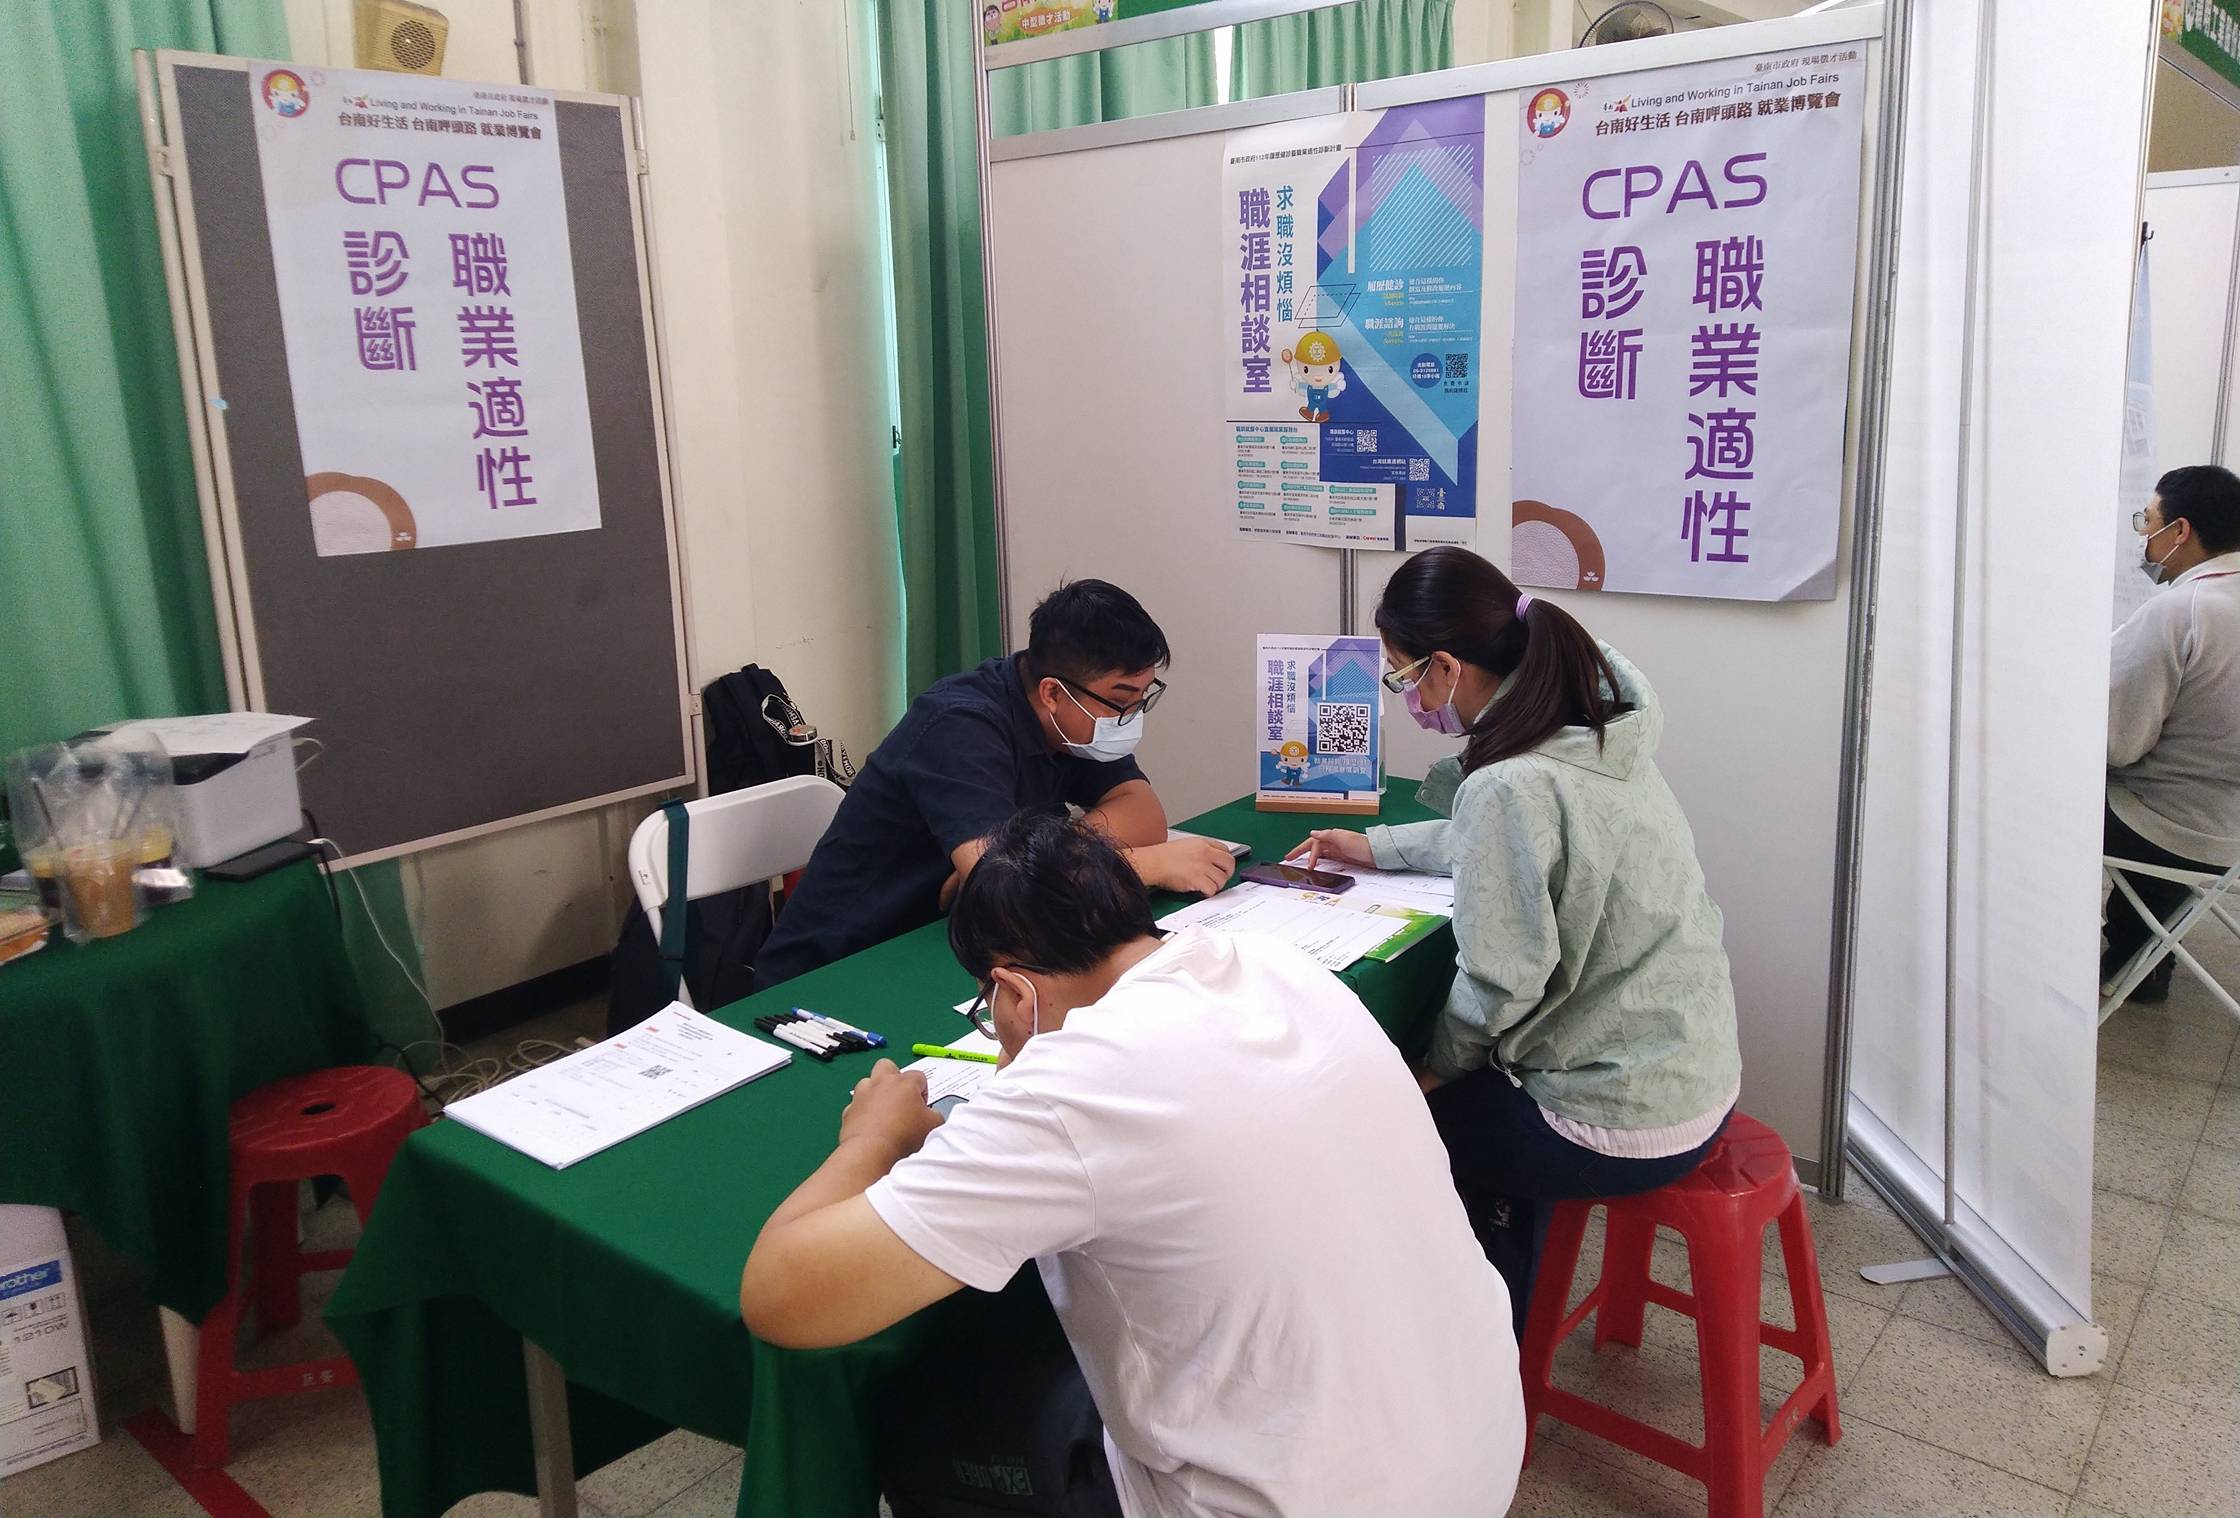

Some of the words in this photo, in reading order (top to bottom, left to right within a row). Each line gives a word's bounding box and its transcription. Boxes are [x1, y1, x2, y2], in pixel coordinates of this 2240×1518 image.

[338, 111, 409, 130] 台南好生活
[370, 98, 398, 111] Living
[400, 100, 417, 111] and
[420, 102, 456, 115] Working
[458, 105, 466, 114] in
[469, 106, 498, 117] Tainan
[499, 108, 516, 119] Job
[518, 109, 539, 120] Fairs
[1595, 111, 1671, 137] 台南好生活
[1675, 101, 1753, 127] 台南呷頭路
[1757, 91, 1841, 117] 就業博覽會
[1631, 96, 1662, 109] Living
[1665, 93, 1685, 105] and
[1687, 87, 1731, 102] Working
[1733, 85, 1743, 95] in
[1746, 80, 1783, 94] Tainan
[1786, 76, 1807, 90] Job
[1810, 73, 1840, 86] Fairs
[335, 158, 500, 209] CPAS
[1582, 152, 1768, 220] CPAS
[1276, 185, 1294, 323] 求職沒煩惱
[343, 230, 417, 371] 診斷
[1239, 187, 1272, 393] 職涯相談室
[1578, 245, 1648, 400] 診斷
[448, 232, 538, 510] 職業適性
[1680, 235, 1765, 563] 職業適性
[1267, 659, 1284, 741] 職涯相談室
[1286, 660, 1297, 714] 求職沒煩惱
[0, 1269, 49, 1291] rother
